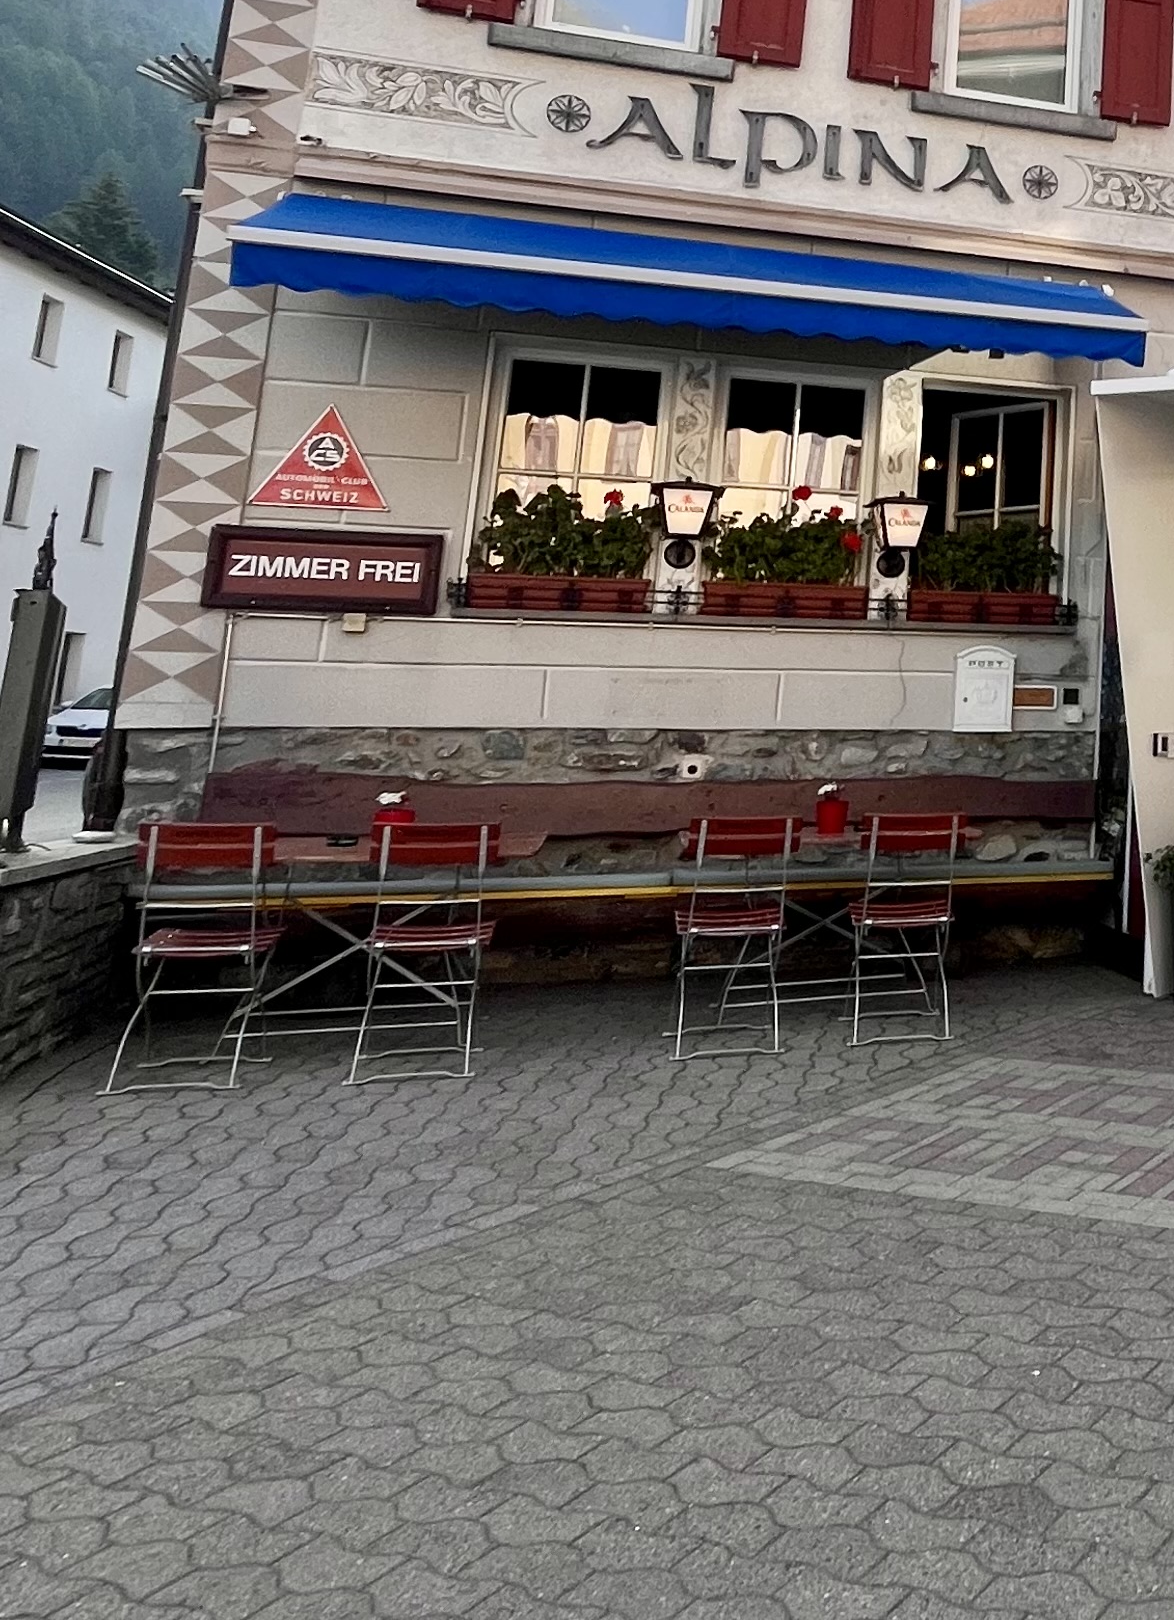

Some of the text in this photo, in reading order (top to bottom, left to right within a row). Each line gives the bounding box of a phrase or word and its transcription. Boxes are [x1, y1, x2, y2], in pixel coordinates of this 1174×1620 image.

[586, 82, 1014, 204] ALPINA
[280, 488, 359, 503] SCHWEIZ
[228, 554, 421, 582] ZIMMER FREI
